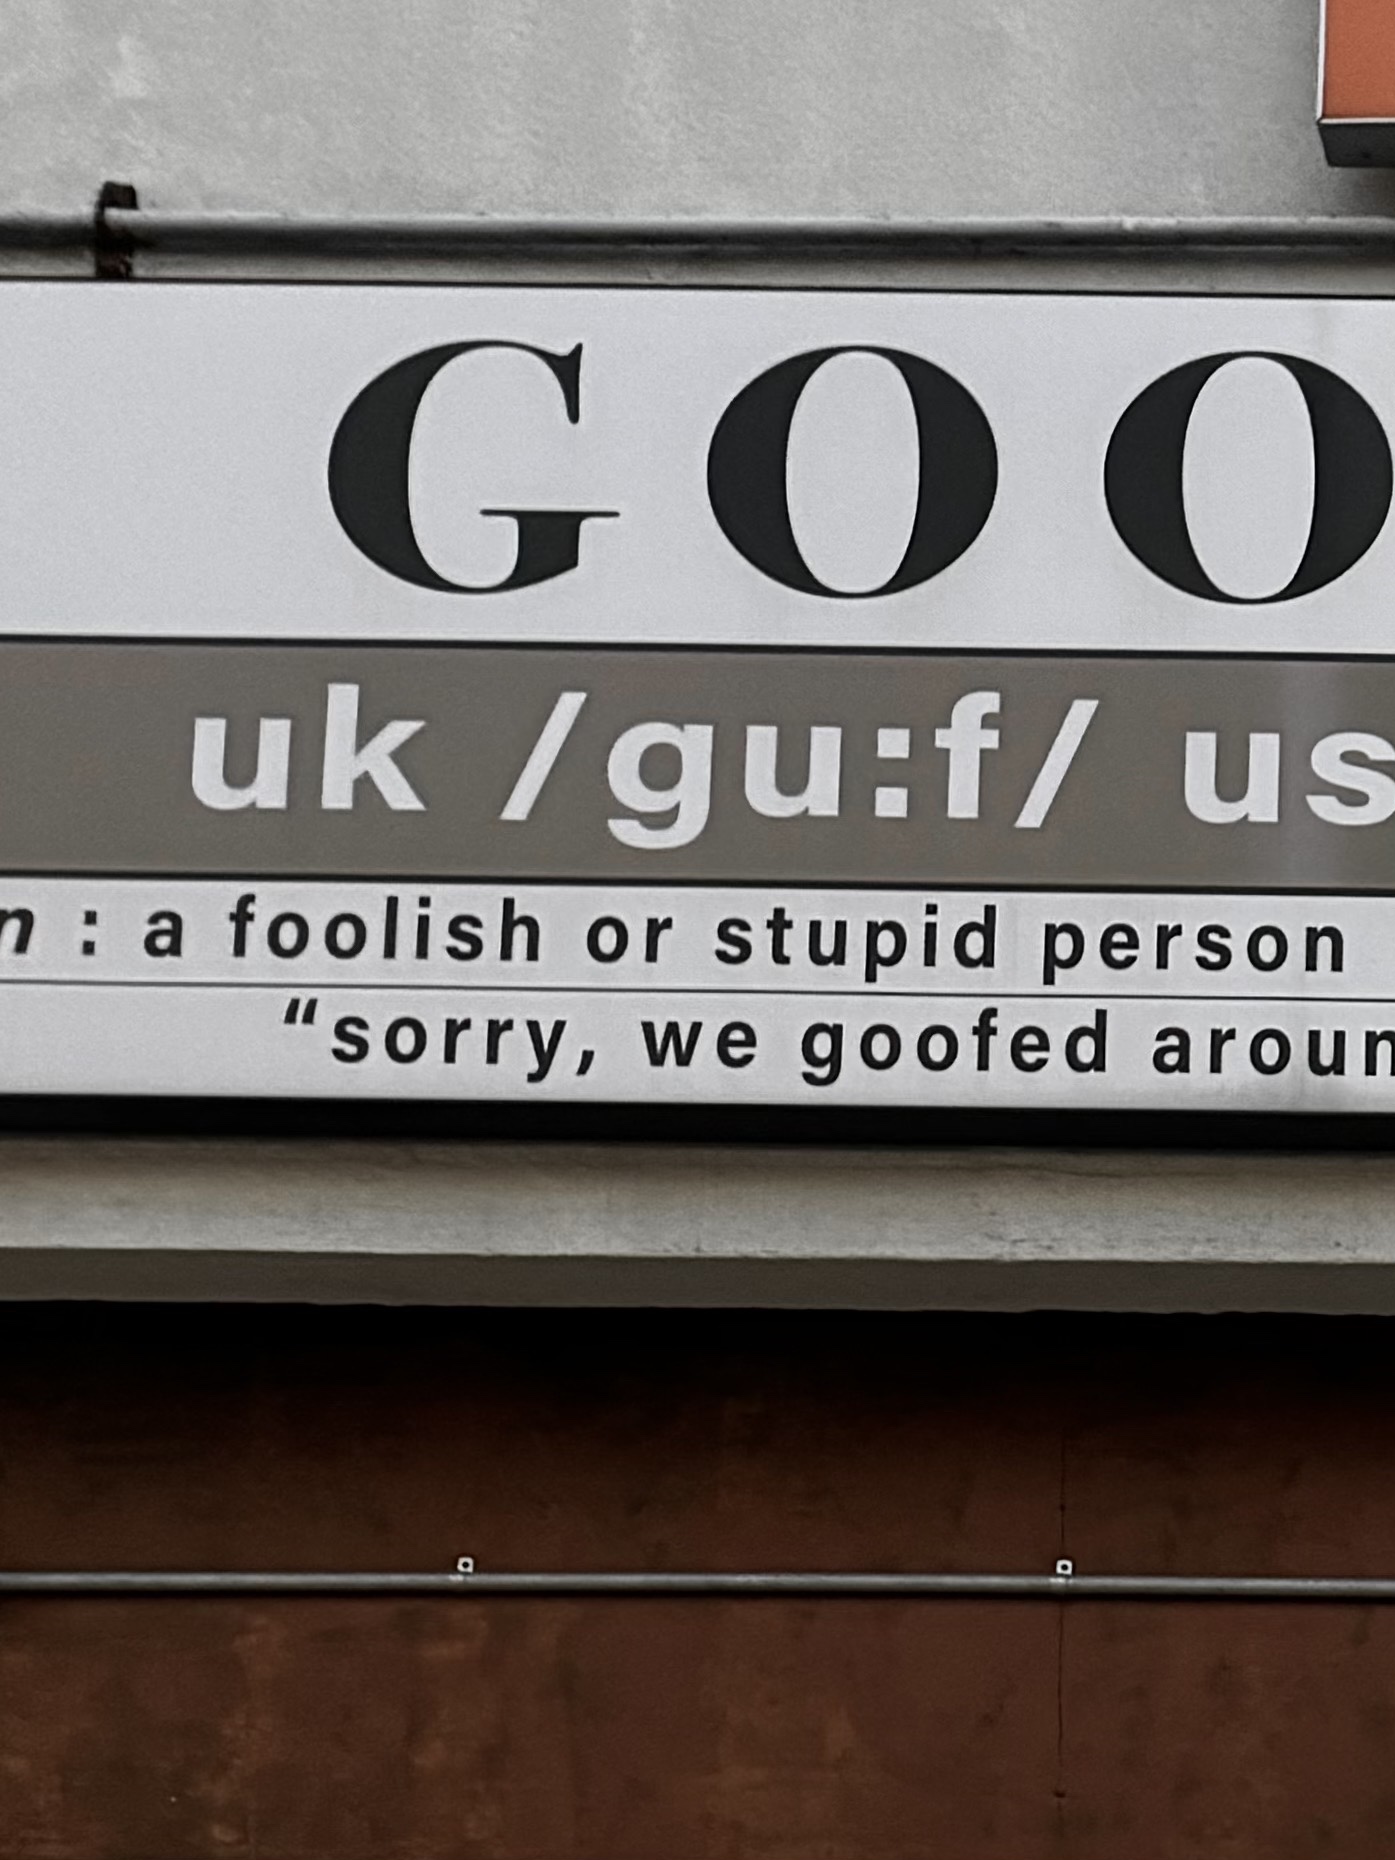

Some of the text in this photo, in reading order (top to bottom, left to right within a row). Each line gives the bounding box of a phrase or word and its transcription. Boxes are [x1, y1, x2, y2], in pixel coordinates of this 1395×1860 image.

[192, 684, 424, 811] uk
[502, 692, 1098, 848] /gu:f/
[144, 911, 183, 957] a
[229, 894, 539, 962] foolish
[587, 917, 672, 963] or
[715, 904, 996, 983] stupid
[1043, 923, 1343, 985] person
[641, 1022, 756, 1068] we
[802, 1008, 1107, 1086] goofed
